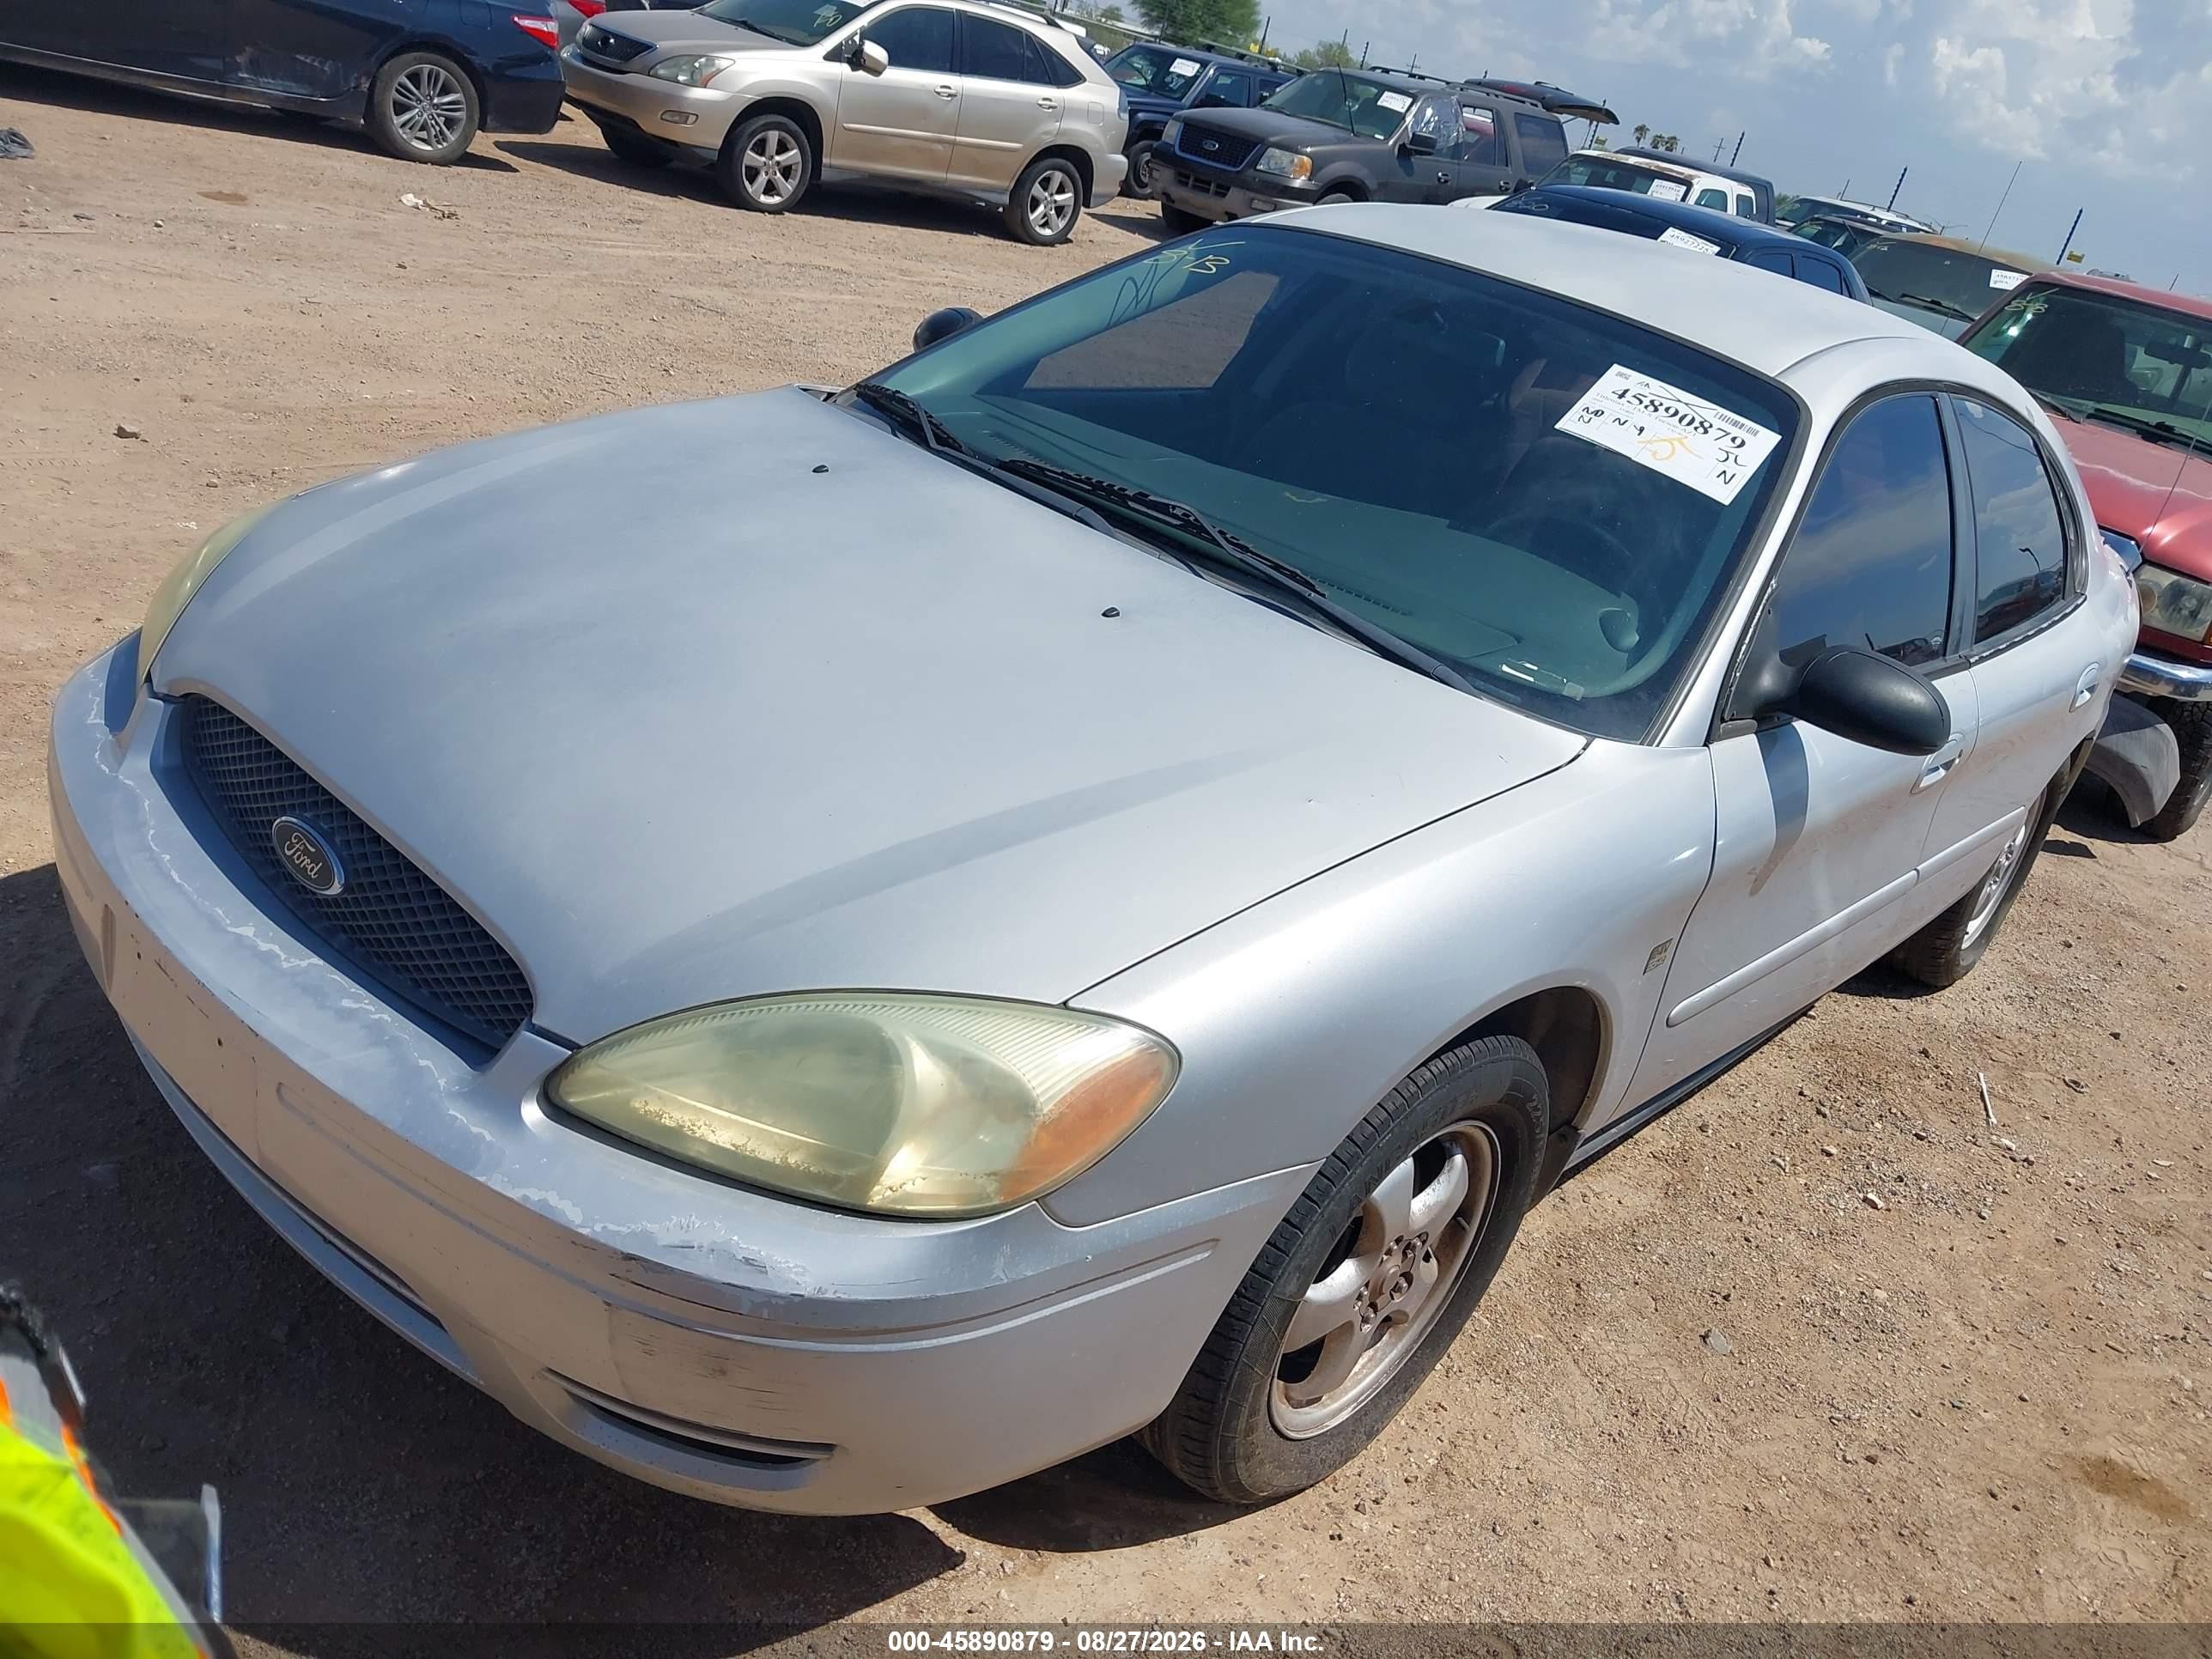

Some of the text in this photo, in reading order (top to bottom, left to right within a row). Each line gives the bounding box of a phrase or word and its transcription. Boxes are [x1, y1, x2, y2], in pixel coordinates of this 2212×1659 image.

[1611, 387, 1747, 449] 45890879
[1716, 470, 1736, 485] N
[284, 832, 323, 878] Ford
